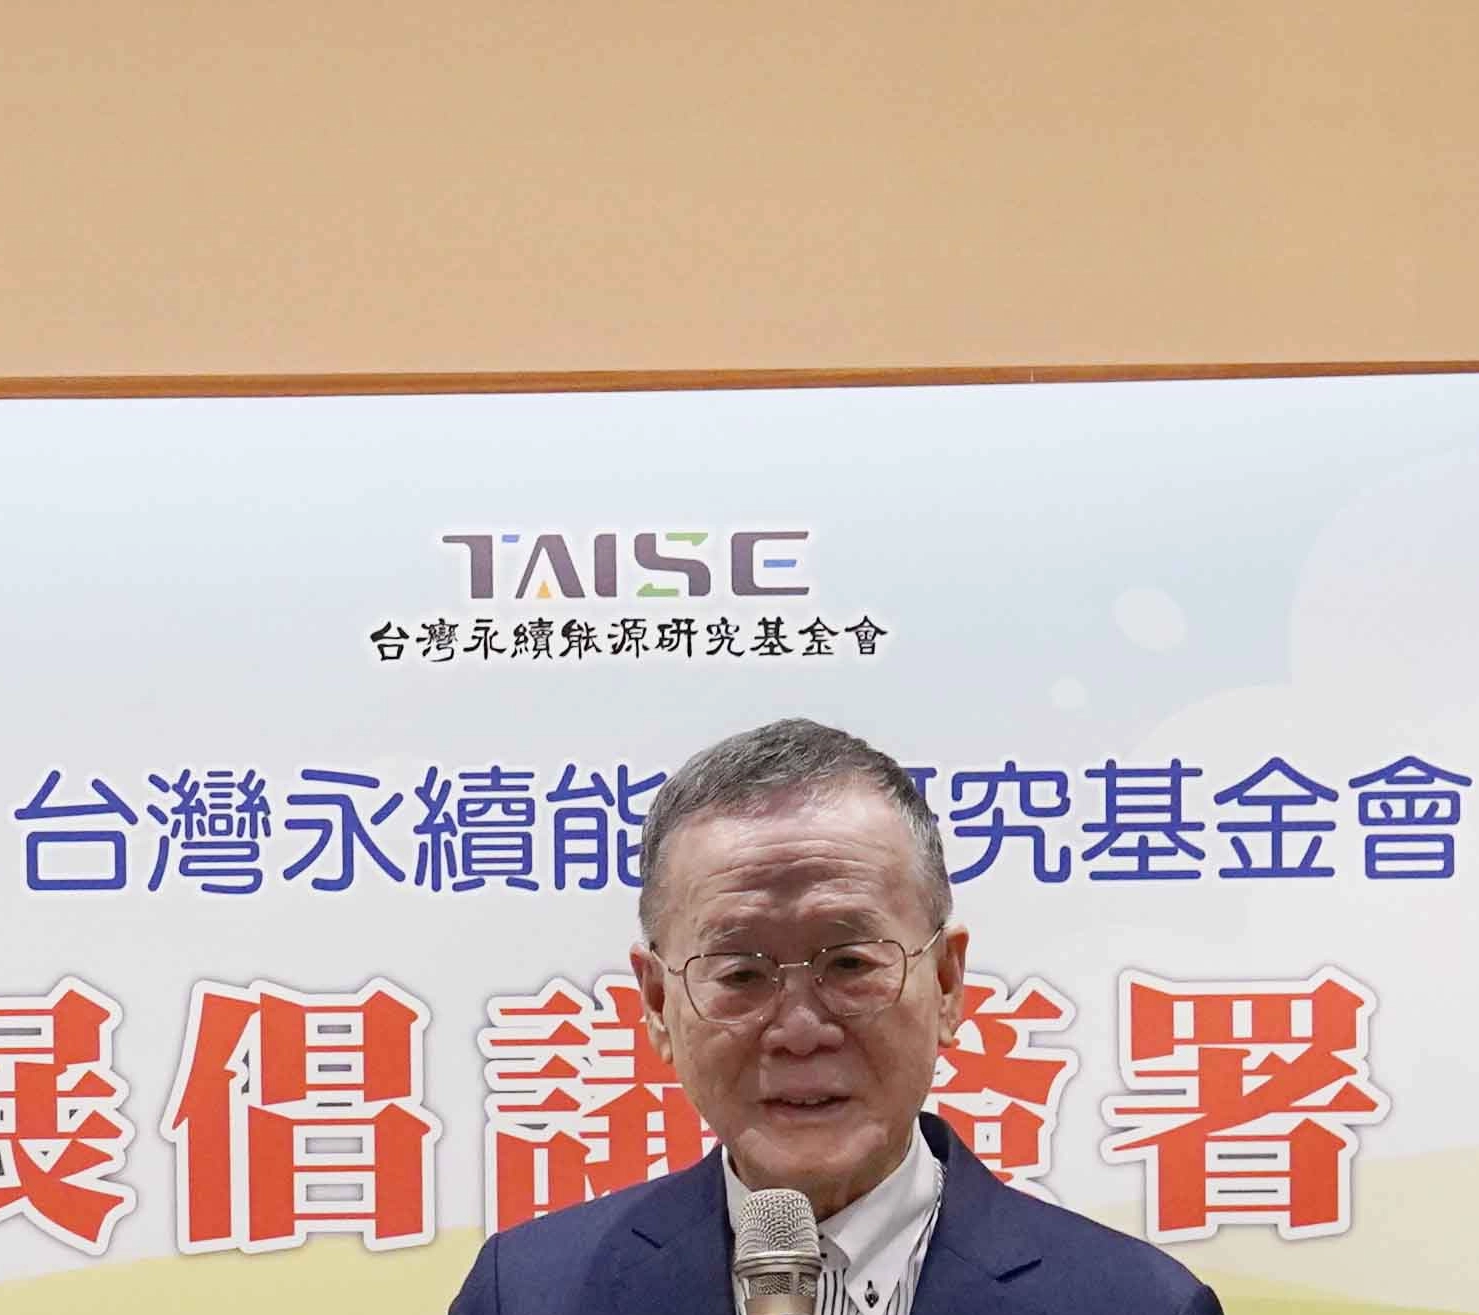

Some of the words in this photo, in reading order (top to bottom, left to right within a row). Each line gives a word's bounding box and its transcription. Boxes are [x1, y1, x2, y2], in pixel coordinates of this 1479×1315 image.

[443, 531, 810, 600] TAISE
[370, 615, 888, 663] 台灣永續能源研究基金會
